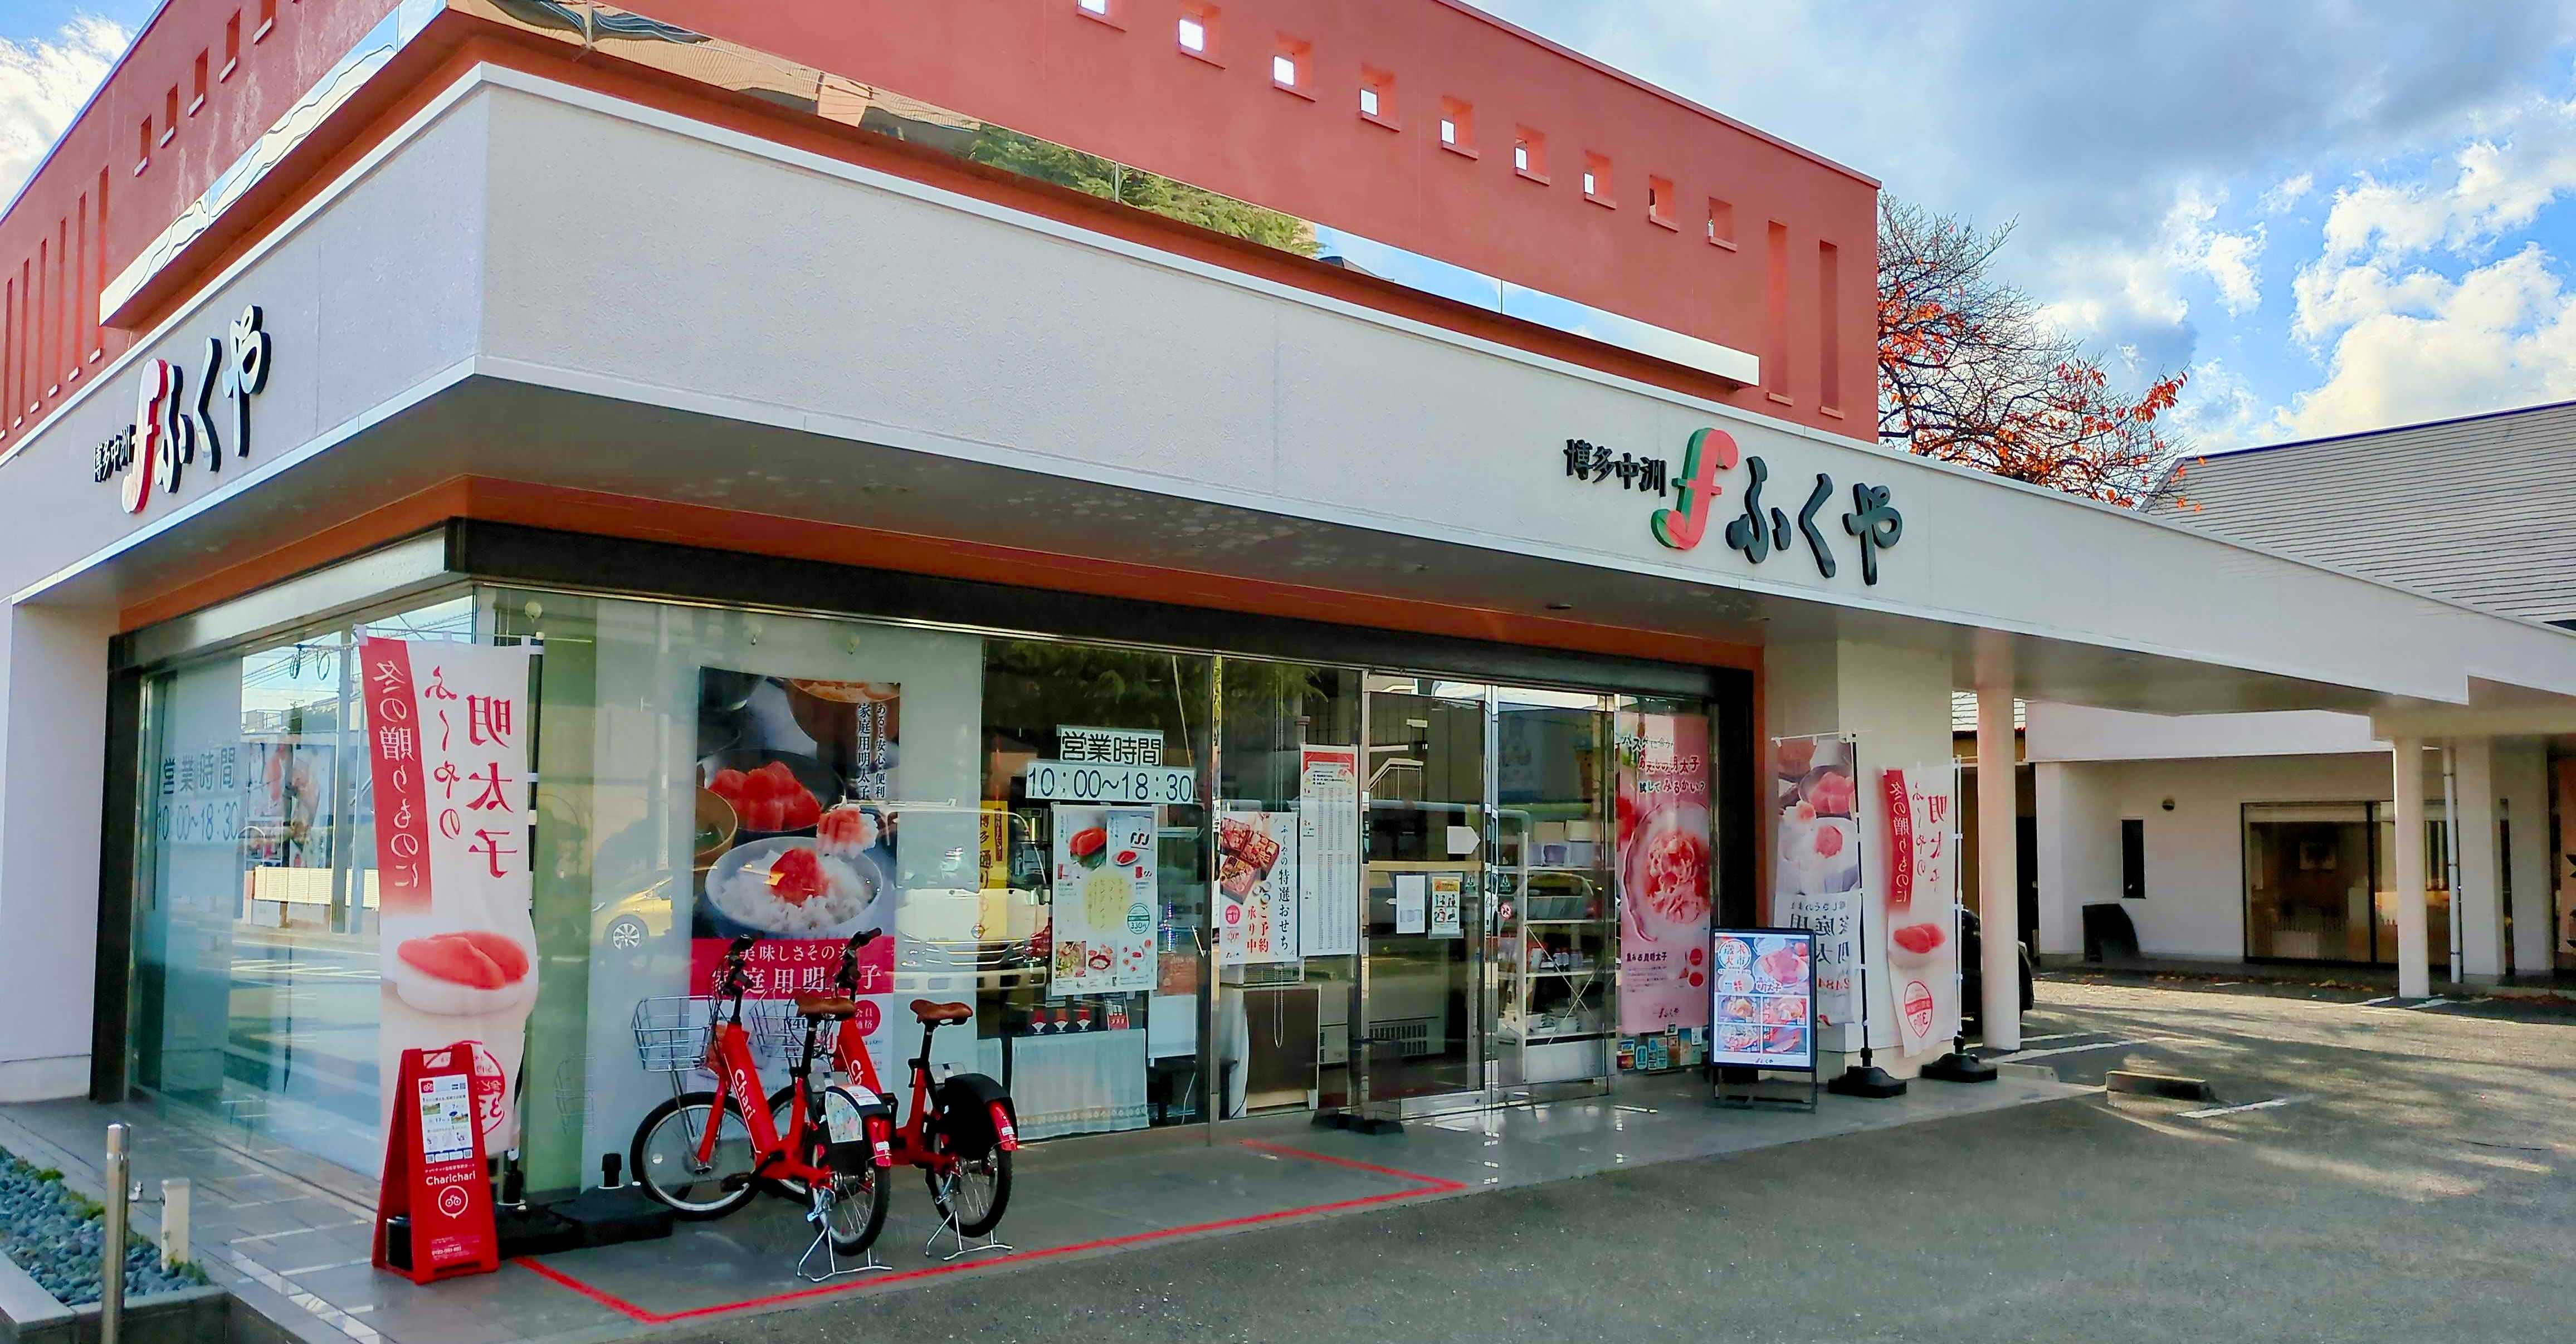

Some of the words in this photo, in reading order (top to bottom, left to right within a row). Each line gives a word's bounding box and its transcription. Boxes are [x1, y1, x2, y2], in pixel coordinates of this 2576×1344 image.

[94, 423, 136, 483] 博多中洲
[154, 305, 271, 493] ふくや
[1563, 438, 1667, 497] 博多中洲
[1726, 456, 1902, 586] ふくや
[857, 702, 871, 800] 家庭用明太子
[1061, 730, 1162, 766] 営業時間
[157, 800, 238, 842] 1000~18:30
[712, 964, 881, 995] 家庭用明子
[735, 1069, 756, 1120] Chari
[426, 1170, 476, 1186] Charichari
